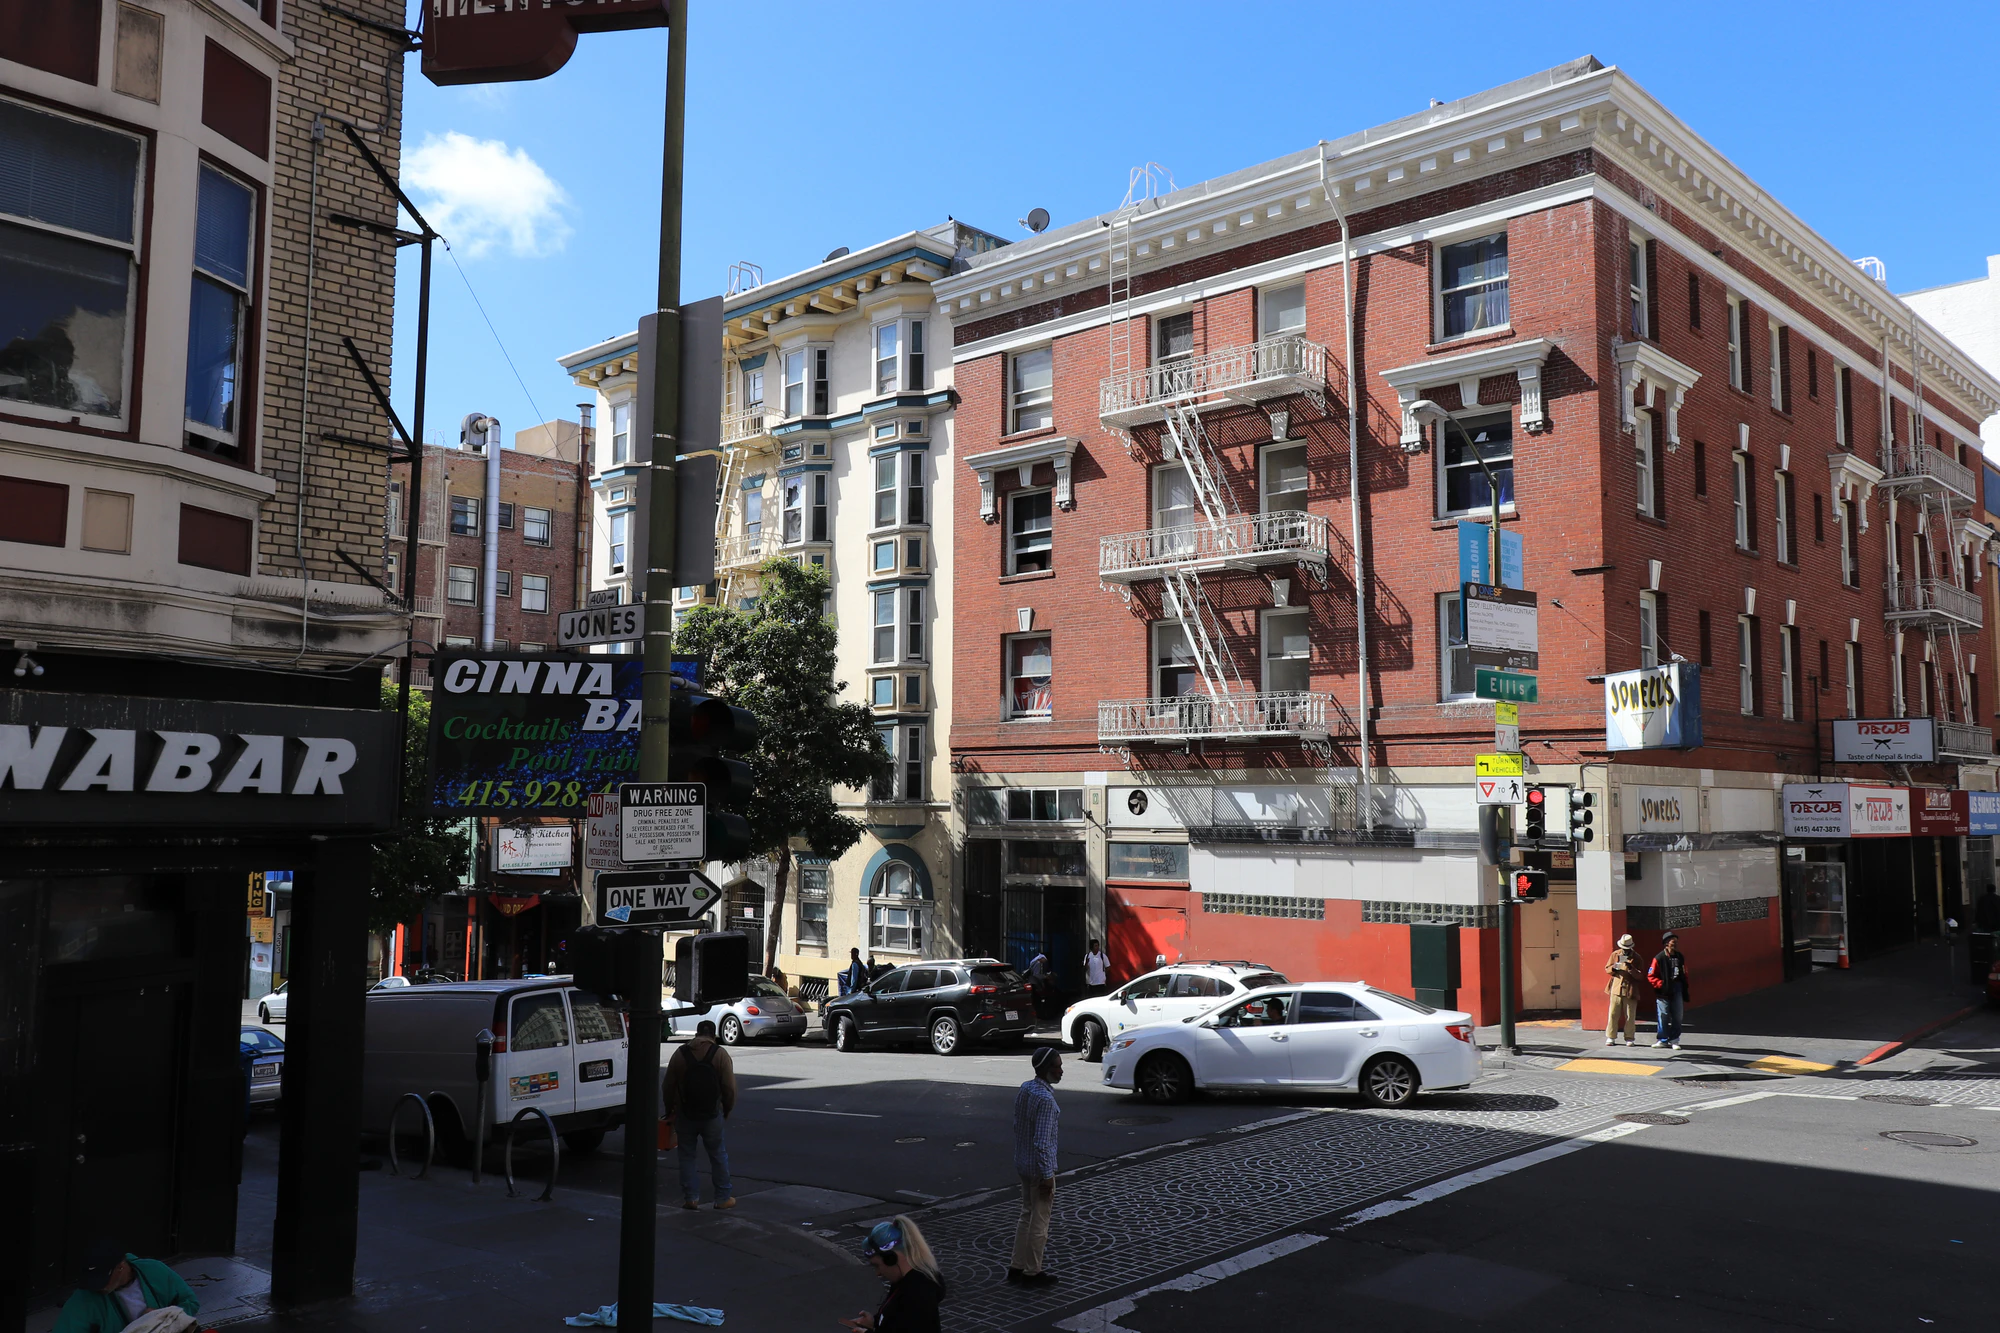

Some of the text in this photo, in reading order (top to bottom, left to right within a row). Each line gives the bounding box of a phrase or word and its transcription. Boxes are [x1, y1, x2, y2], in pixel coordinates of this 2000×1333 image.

[591, 592, 607, 604] 400
[1469, 601, 1480, 609] EDDY
[1483, 602, 1492, 611] ELLIS
[1514, 607, 1536, 616] CONTRACT
[564, 610, 636, 640] JONES
[443, 659, 613, 695] CINNA
[1490, 677, 1525, 696] Ellis
[582, 698, 642, 732] BA
[1497, 705, 1511, 714] TURNING
[443, 716, 573, 742] Cocktails
[508, 747, 641, 772] Pool Tabl
[1492, 757, 1520, 765] TURNING
[1875, 753, 1896, 761] Nepal
[1492, 765, 1521, 773] VEHICLES
[458, 780, 623, 808] 415.928.
[629, 788, 697, 804] WARNING
[589, 796, 602, 817] NO
[634, 808, 693, 818] DRUG FREE ZONE
[538, 828, 570, 839] Kitchen
[591, 823, 597, 837] 6
[614, 823, 619, 837] 8
[1811, 825, 1841, 833] 447-3876
[500, 839, 517, 855] 林
[599, 839, 619, 848] EVERYDA
[588, 848, 611, 856] INCLUDING
[590, 858, 607, 867] STREET
[610, 886, 688, 909] ONE WAY
